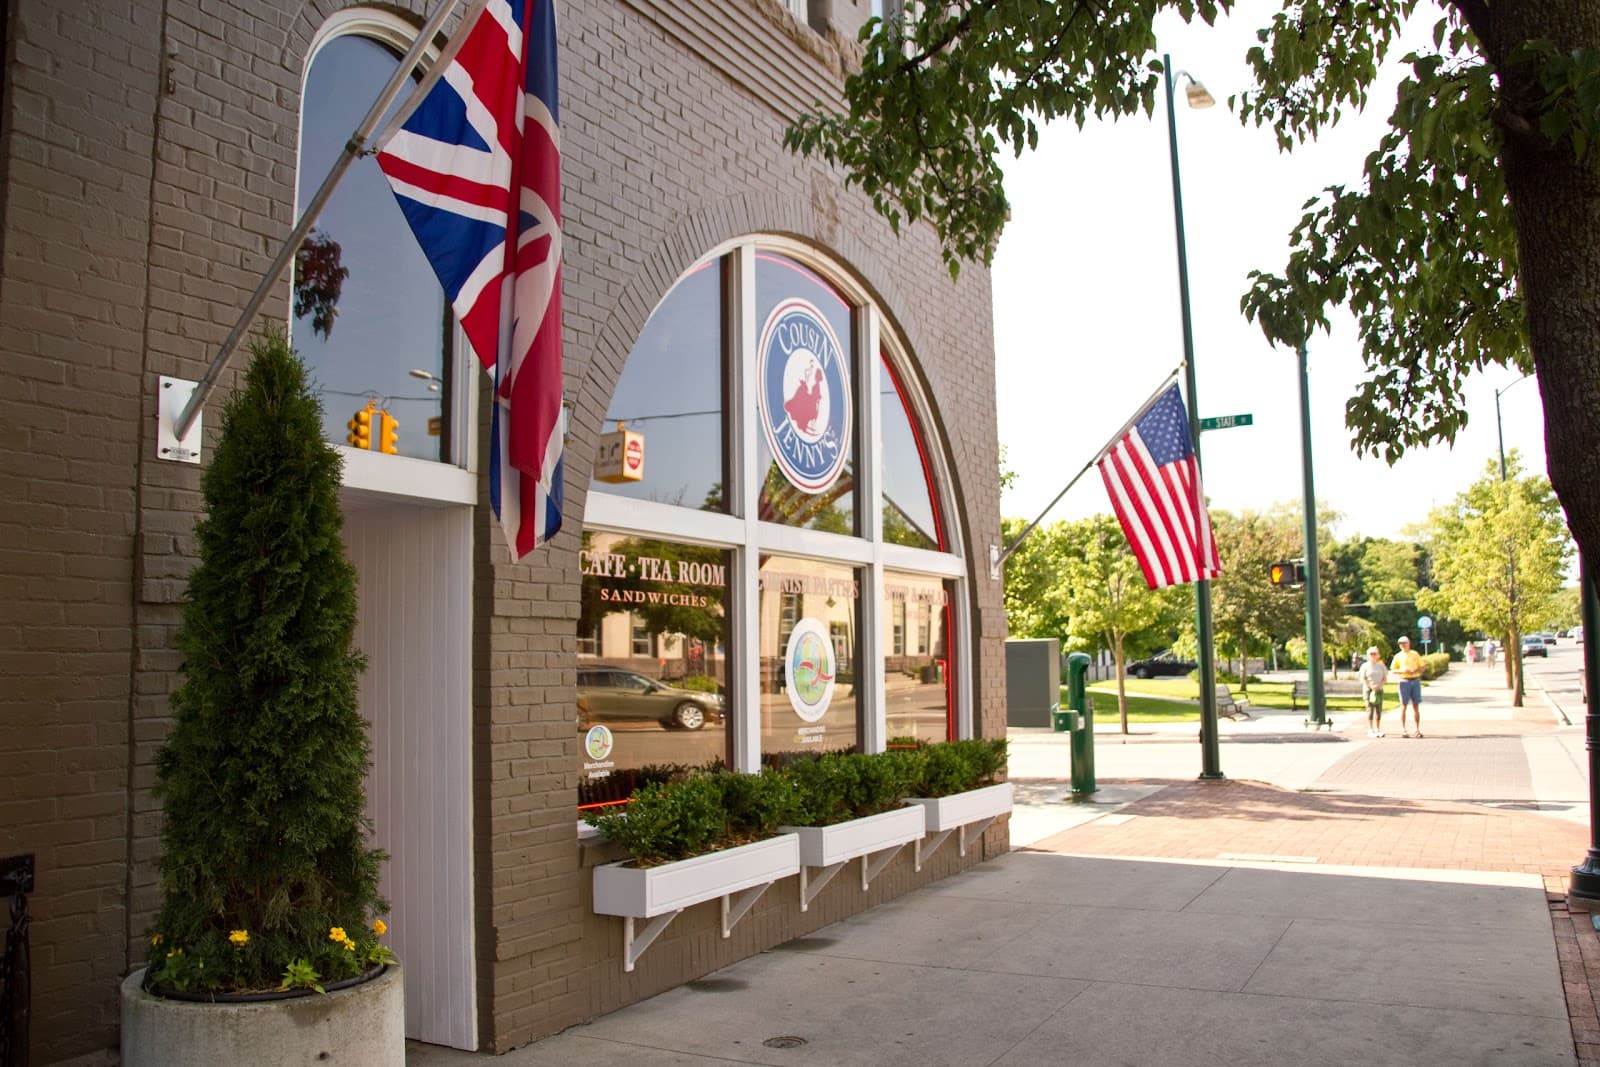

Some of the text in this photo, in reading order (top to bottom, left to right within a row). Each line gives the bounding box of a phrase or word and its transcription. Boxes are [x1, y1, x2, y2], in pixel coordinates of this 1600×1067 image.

[777, 322, 834, 368] COUSIN
[1216, 416, 1236, 427] STATE
[774, 418, 838, 468] JENNY'S
[579, 550, 725, 586] CAFE TEA ROOM
[601, 588, 707, 607] SANDWICHES
